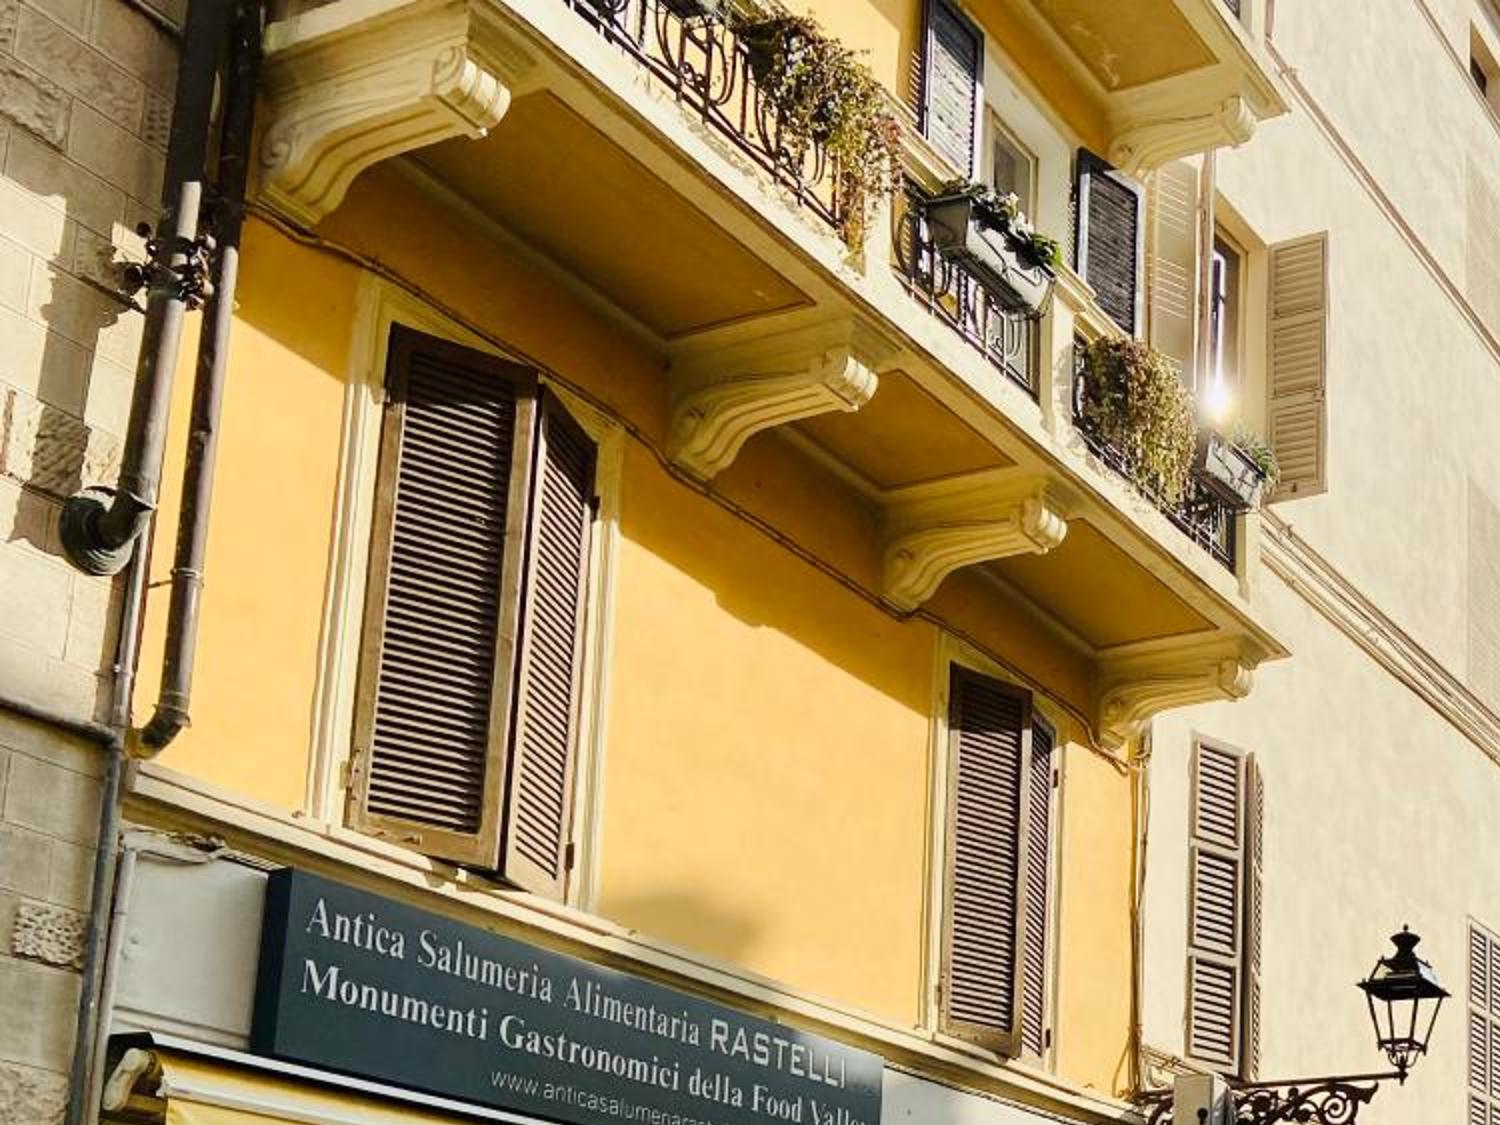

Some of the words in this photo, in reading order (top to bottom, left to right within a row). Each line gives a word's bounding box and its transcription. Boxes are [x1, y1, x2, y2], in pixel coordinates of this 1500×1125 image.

[301, 959, 488, 1040] Monumenti
[499, 1014, 680, 1091] Gastronomici
[689, 1067, 743, 1107] della
[751, 1083, 801, 1124] Food
[306, 897, 405, 959] Antica
[417, 928, 552, 1003] Salumeria
[563, 976, 700, 1047] Alimentaria
[711, 1018, 846, 1089] RASTELLI
